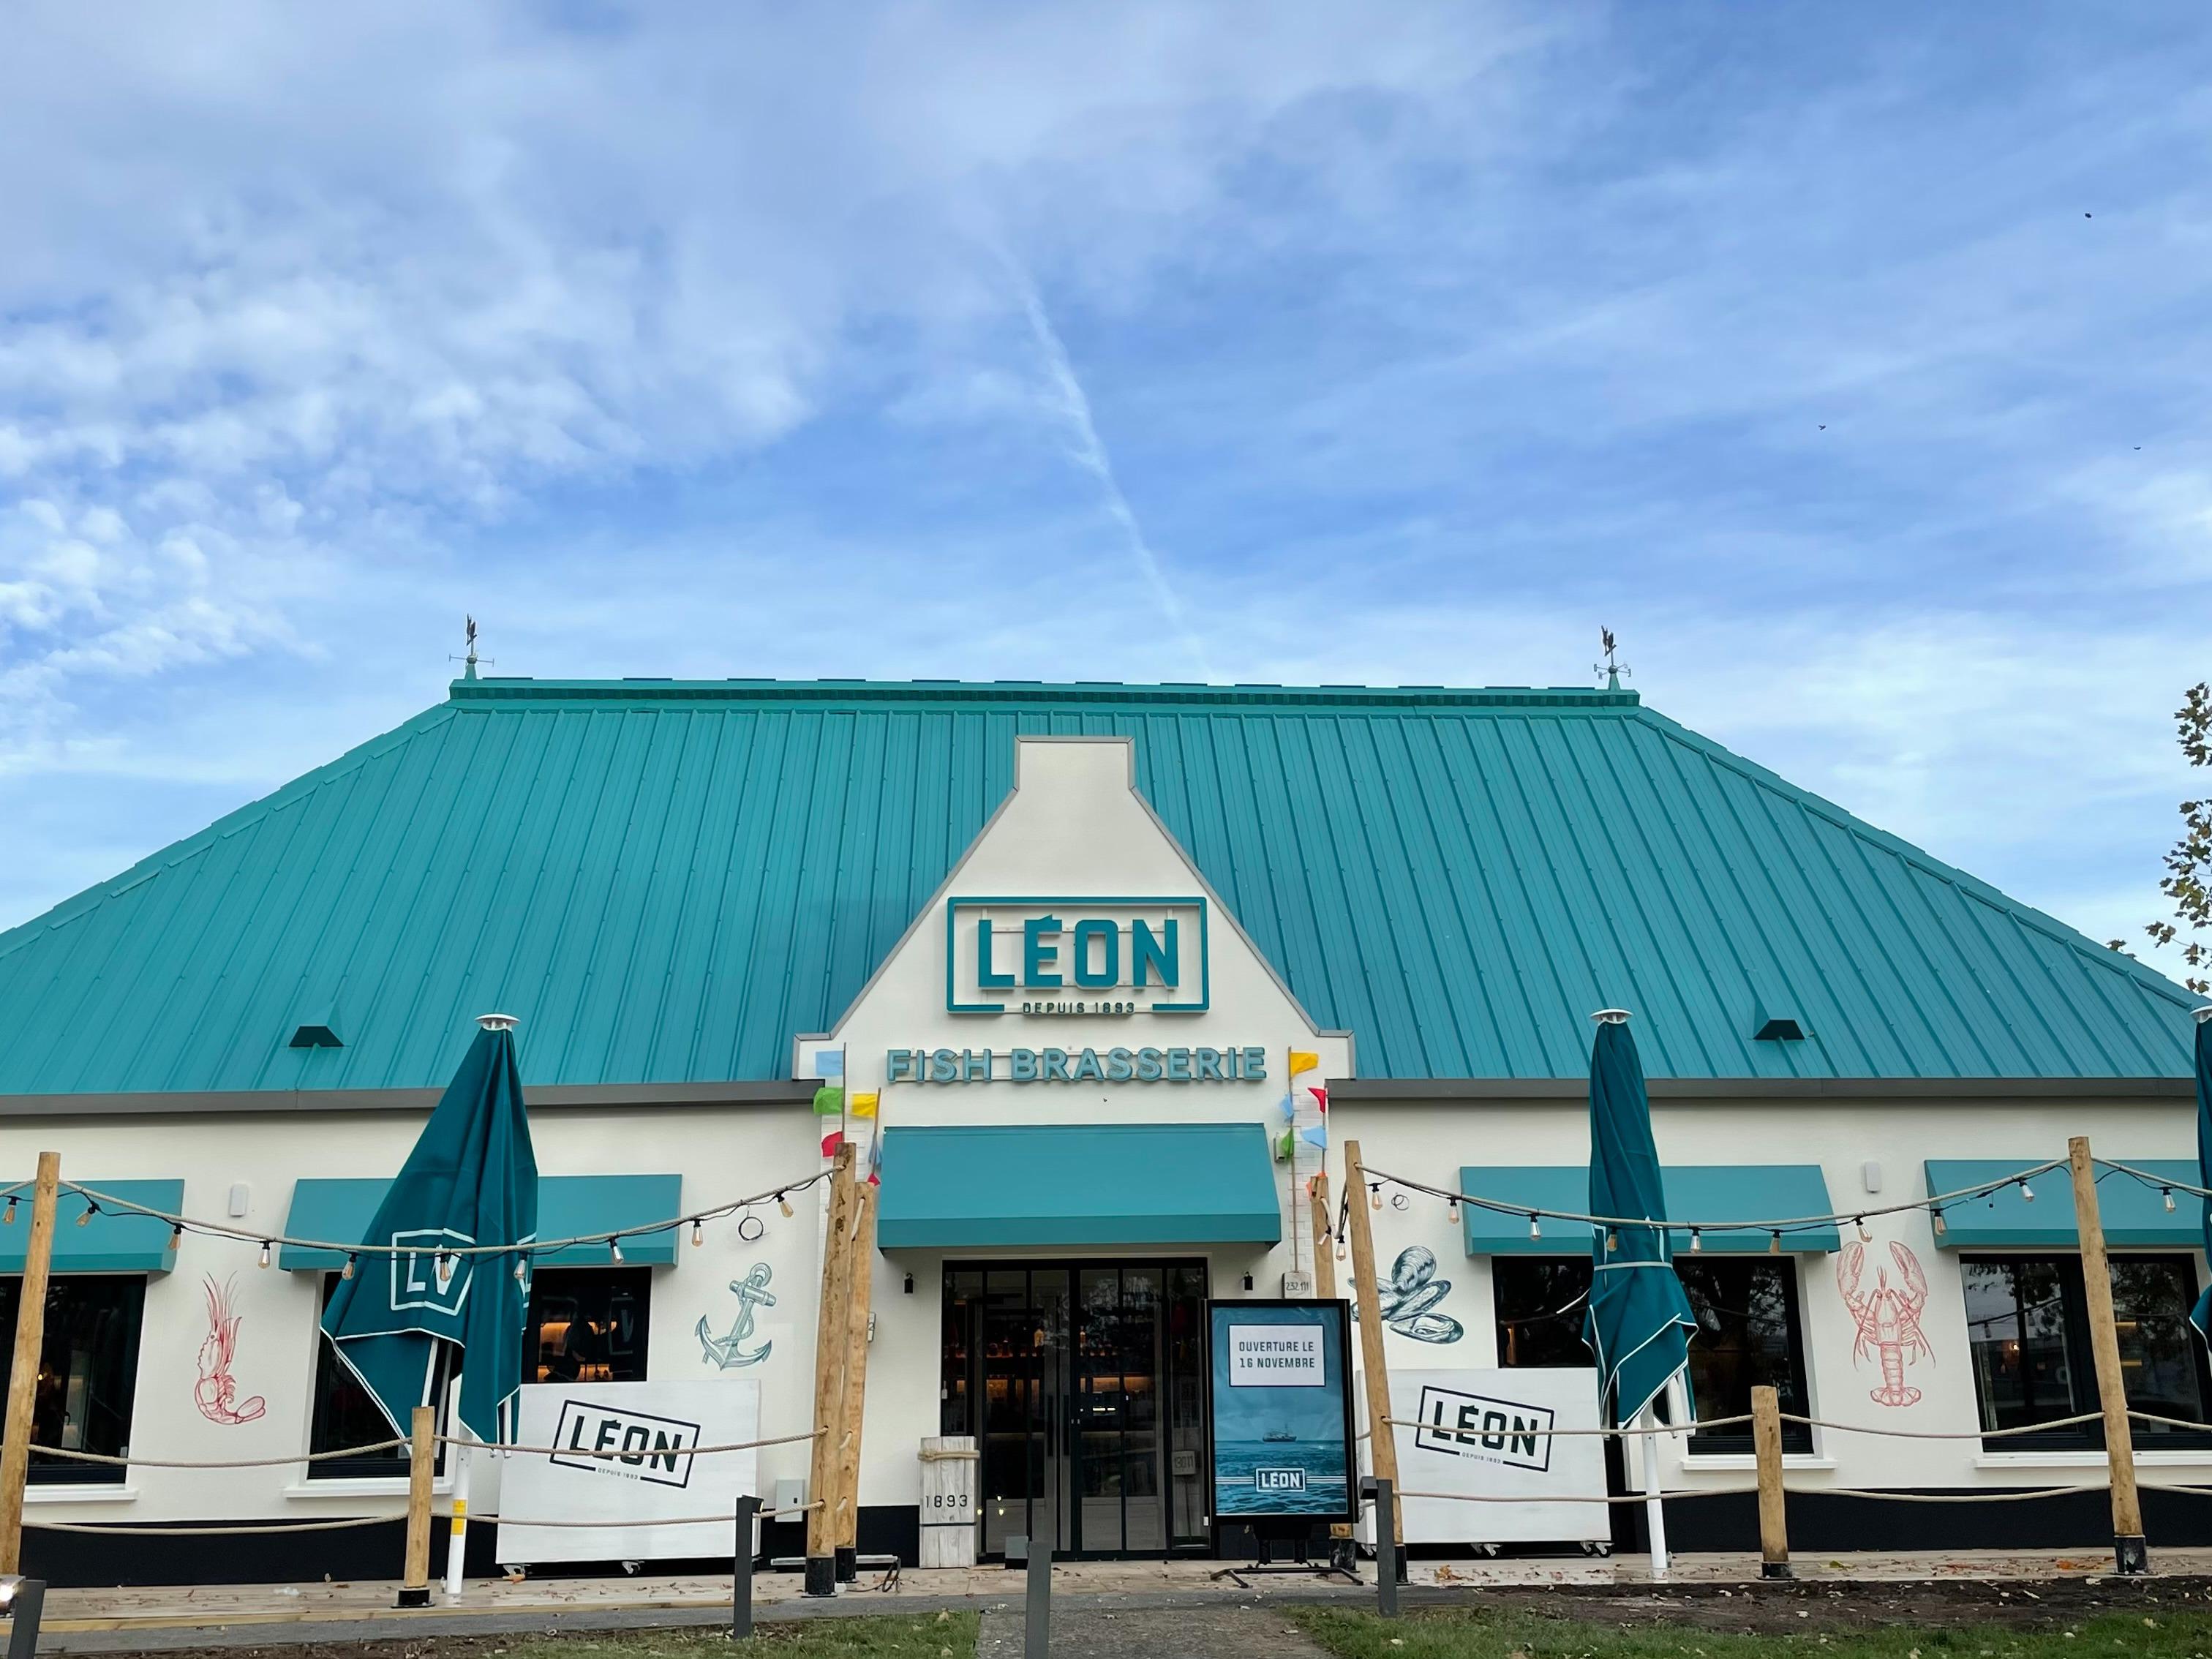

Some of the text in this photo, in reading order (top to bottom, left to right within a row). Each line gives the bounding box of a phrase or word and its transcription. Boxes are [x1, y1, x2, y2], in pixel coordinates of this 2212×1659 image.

[978, 914, 1178, 988] LÉON
[1023, 1002, 1135, 1014] DEPUIS 1893
[887, 1047, 1267, 1083] FISH BRASSERIE
[1238, 1342, 1314, 1352] OUVERTURE LE
[1240, 1358, 1315, 1368] 16 NOVEMBRE
[1432, 1401, 1538, 1456] LÉON
[569, 1415, 682, 1472] LÉON
[925, 1494, 968, 1508] 1893
